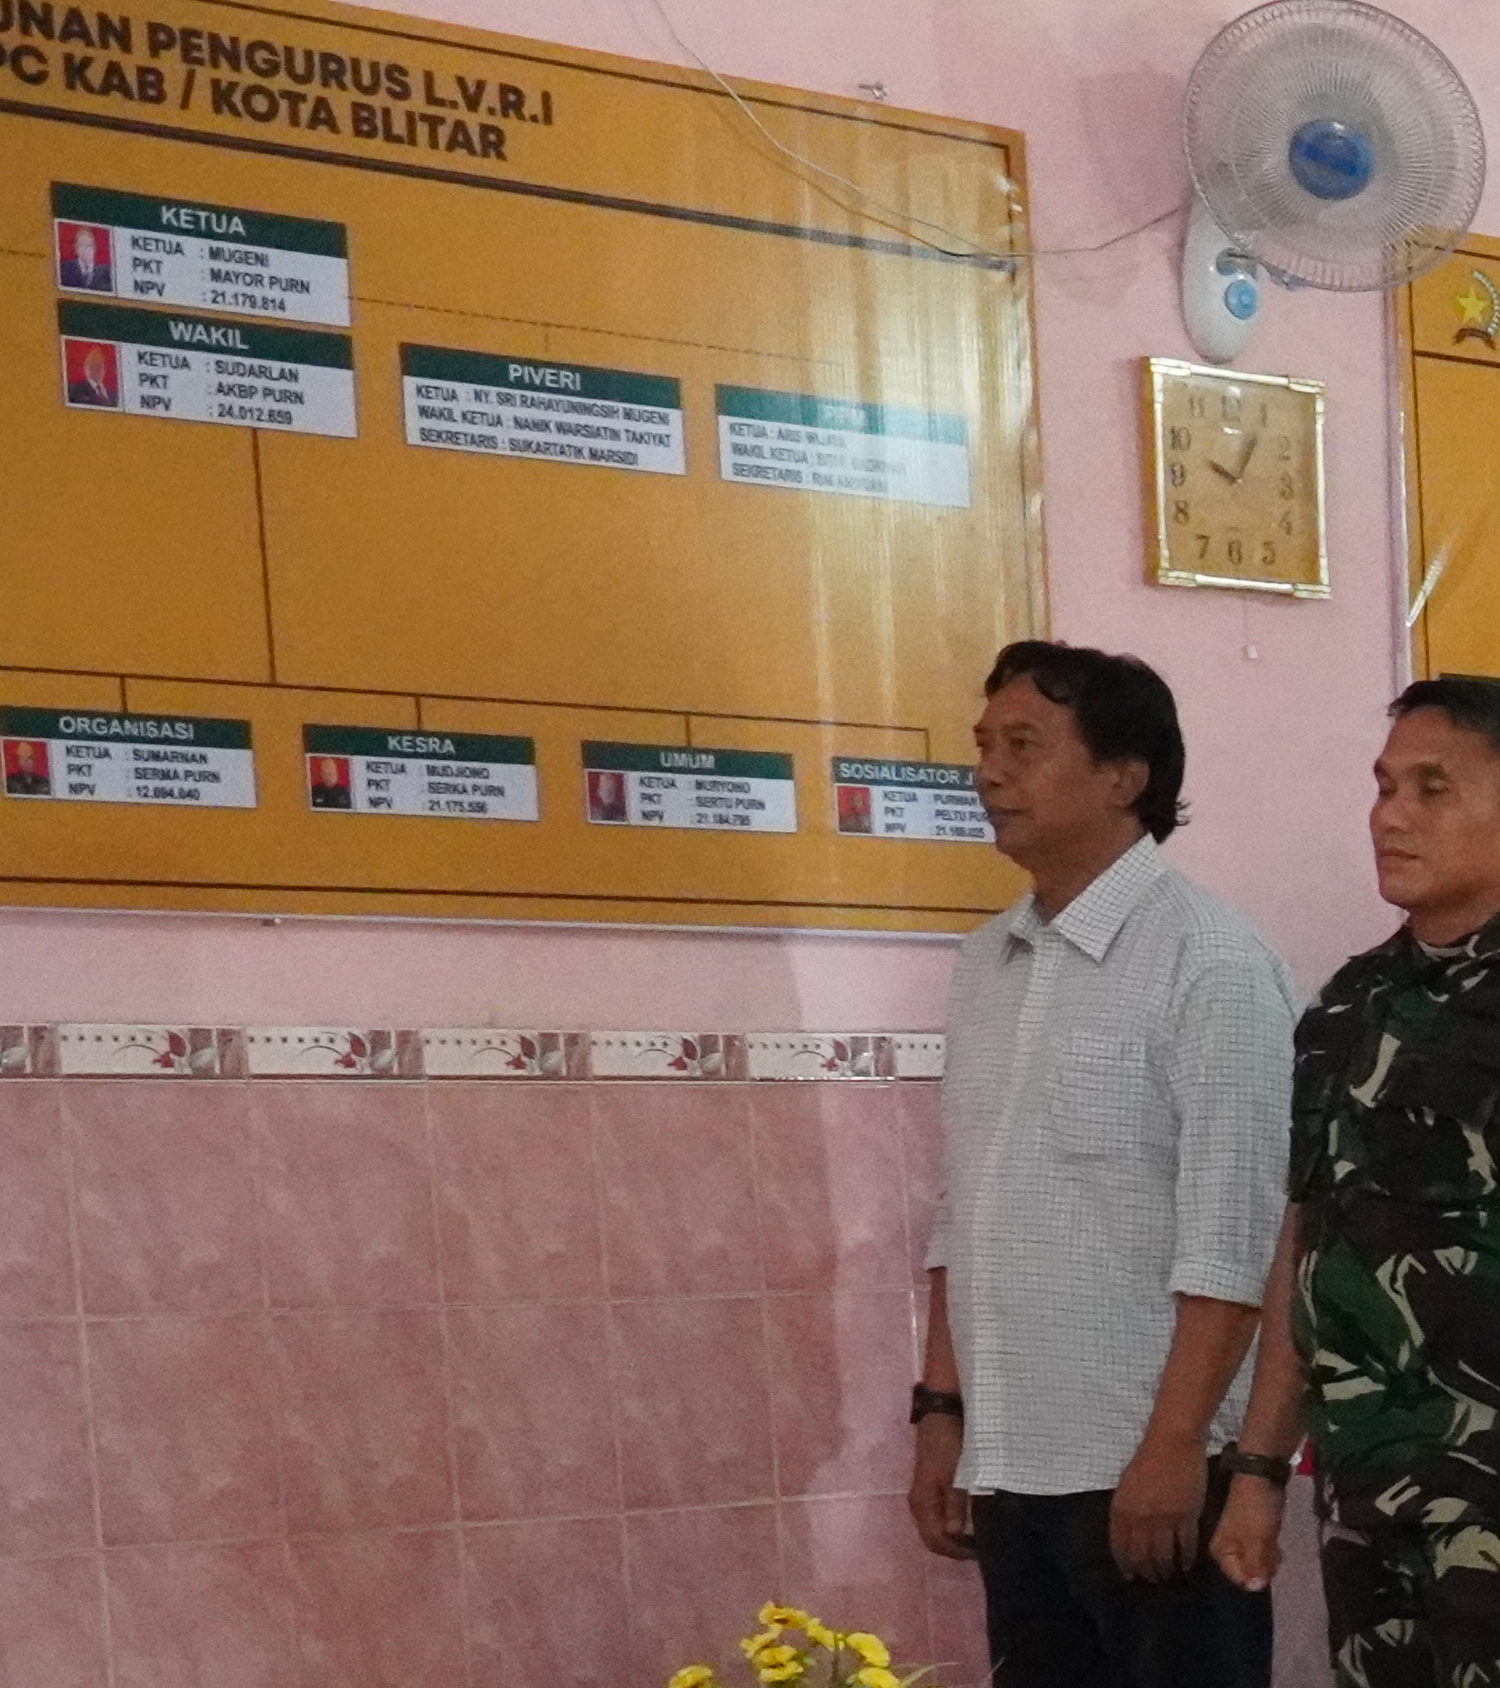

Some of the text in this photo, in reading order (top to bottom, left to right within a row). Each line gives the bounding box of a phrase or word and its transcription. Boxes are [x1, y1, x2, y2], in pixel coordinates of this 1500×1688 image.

[147, 20, 554, 125] PENGURUS L.V.R.I
[63, 52, 165, 103] KAB
[211, 78, 340, 133] KOTA
[351, 102, 507, 159] BLITAR
[161, 205, 245, 236] KETUA
[132, 235, 269, 267] KETUA MUGENI
[133, 257, 310, 295] PKT MAYOR PURN
[134, 280, 165, 297] NPV
[168, 321, 249, 350] WAKIL
[138, 351, 299, 383] KETUA SUDARLAN
[508, 364, 581, 391] PIVERI
[139, 373, 168, 389] PKT
[263, 389, 304, 404] PURN
[416, 384, 458, 402] KETUA
[141, 395, 171, 411] NPV
[417, 405, 457, 422] WAKIL
[461, 410, 503, 428] KETUA
[420, 428, 498, 450] SEKRETARIS
[1170, 462, 1186, 488] 9
[1174, 501, 1189, 524] 8
[1197, 534, 1275, 565] 7 6 5
[59, 716, 194, 740] ORGANISASI
[66, 745, 111, 759] KETUA
[388, 736, 455, 754] KESRA
[366, 761, 406, 775] KETUA
[660, 752, 715, 769] UMUM
[67, 764, 93, 777] PKT
[185, 770, 220, 783] PURN
[367, 779, 391, 791] PKT
[839, 763, 960, 784] SOSIALISATOR
[69, 783, 95, 796] NPV
